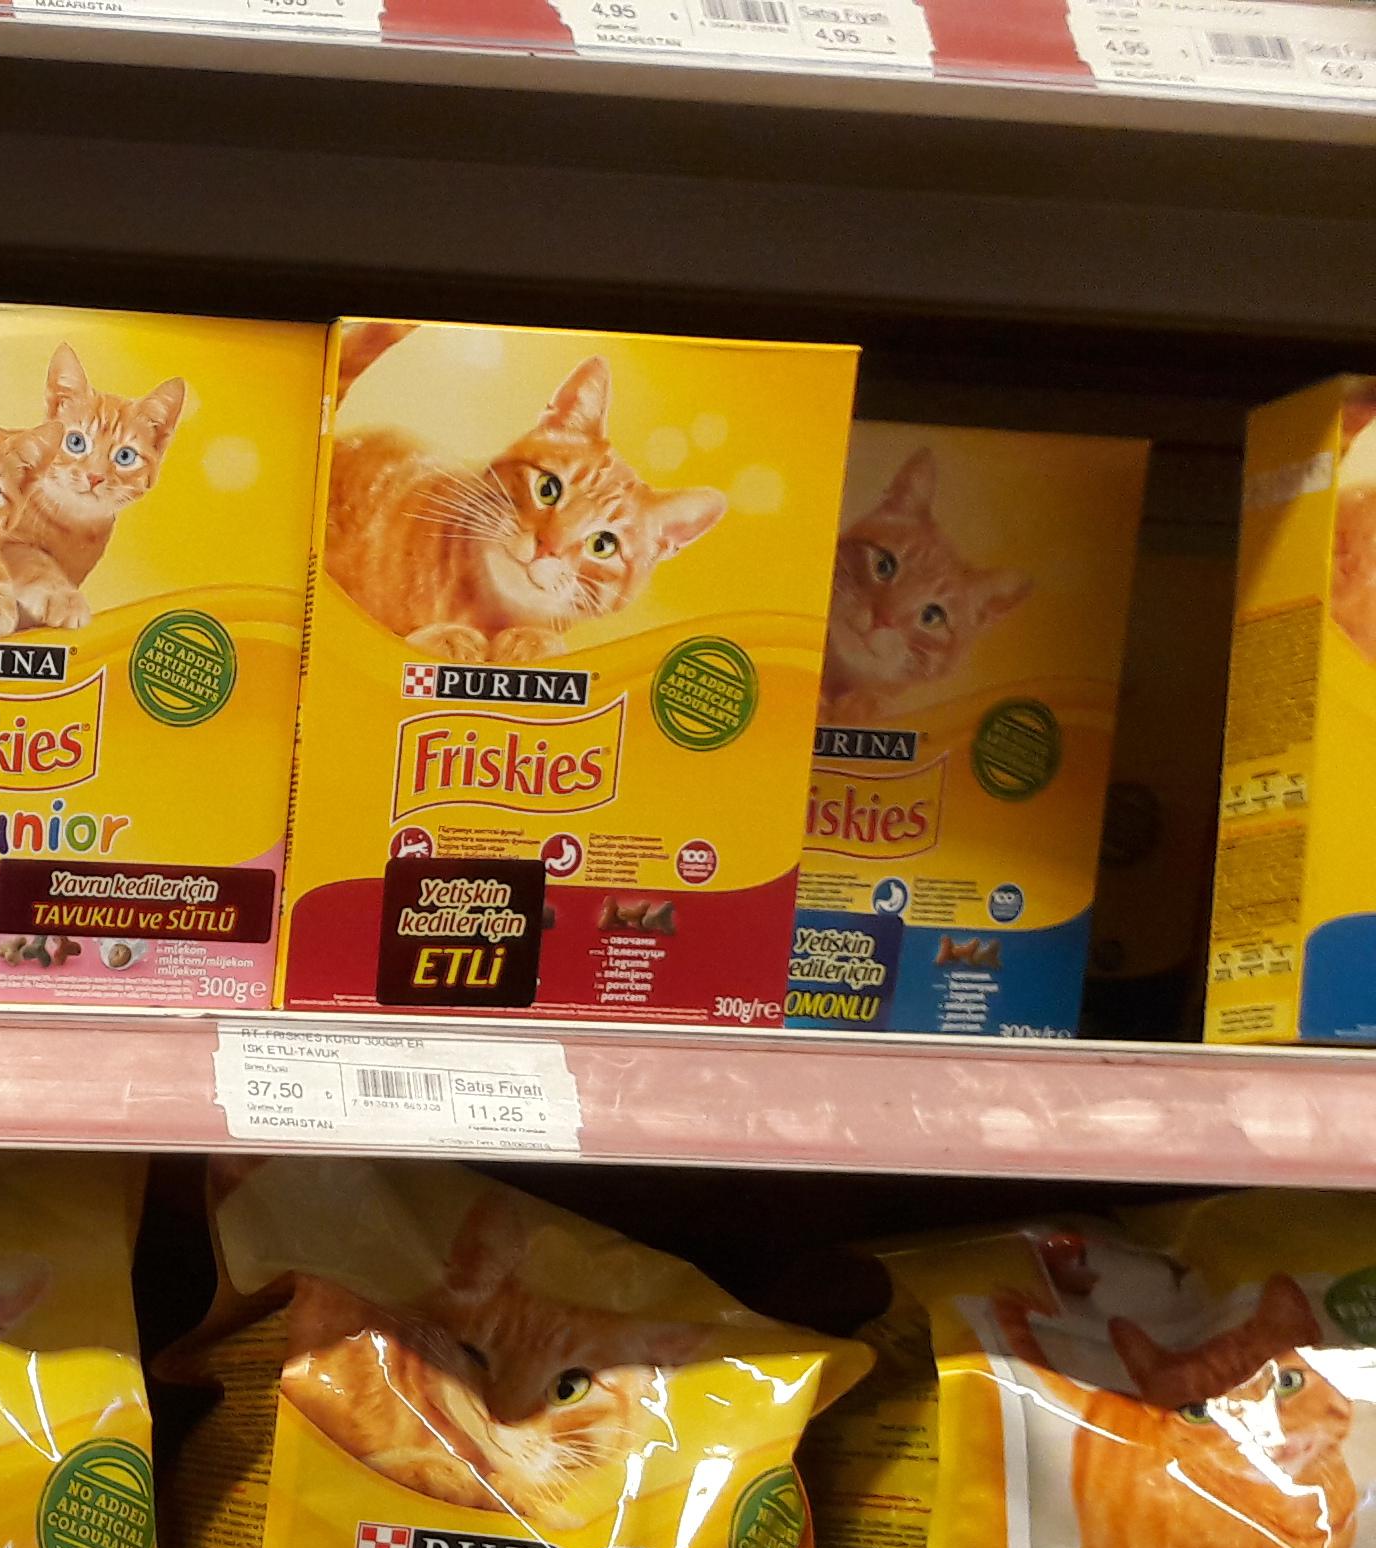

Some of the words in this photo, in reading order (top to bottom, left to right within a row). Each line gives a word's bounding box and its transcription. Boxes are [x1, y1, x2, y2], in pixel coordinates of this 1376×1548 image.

[143, 647, 221, 691] ARTIFICIAL
[153, 634, 175, 653] NO
[175, 644, 223, 677] ADDED
[137, 657, 220, 705] COLOURANTS
[443, 672, 582, 701] PURINA
[412, 730, 604, 797] Friskies
[50, 872, 110, 897] Yavru
[111, 874, 183, 899] kediler
[183, 876, 219, 905] için
[419, 877, 512, 913] Yetişkin
[33, 904, 134, 930] TAVUKLU
[138, 909, 163, 930] ve
[167, 905, 238, 933] SÜTLÜ
[398, 907, 480, 937] kediler
[481, 913, 526, 941] için
[794, 928, 876, 969] Yetişkin
[847, 962, 886, 987] için
[247, 1080, 303, 1100] 37,50
[454, 1077, 494, 1095] Satış
[498, 1080, 543, 1098] Fiyatı
[467, 1104, 523, 1124] 11,25
[67, 1479, 92, 1501] NO
[95, 1493, 147, 1526] ADDED
[56, 1496, 144, 1548] ARTIFICIAL
